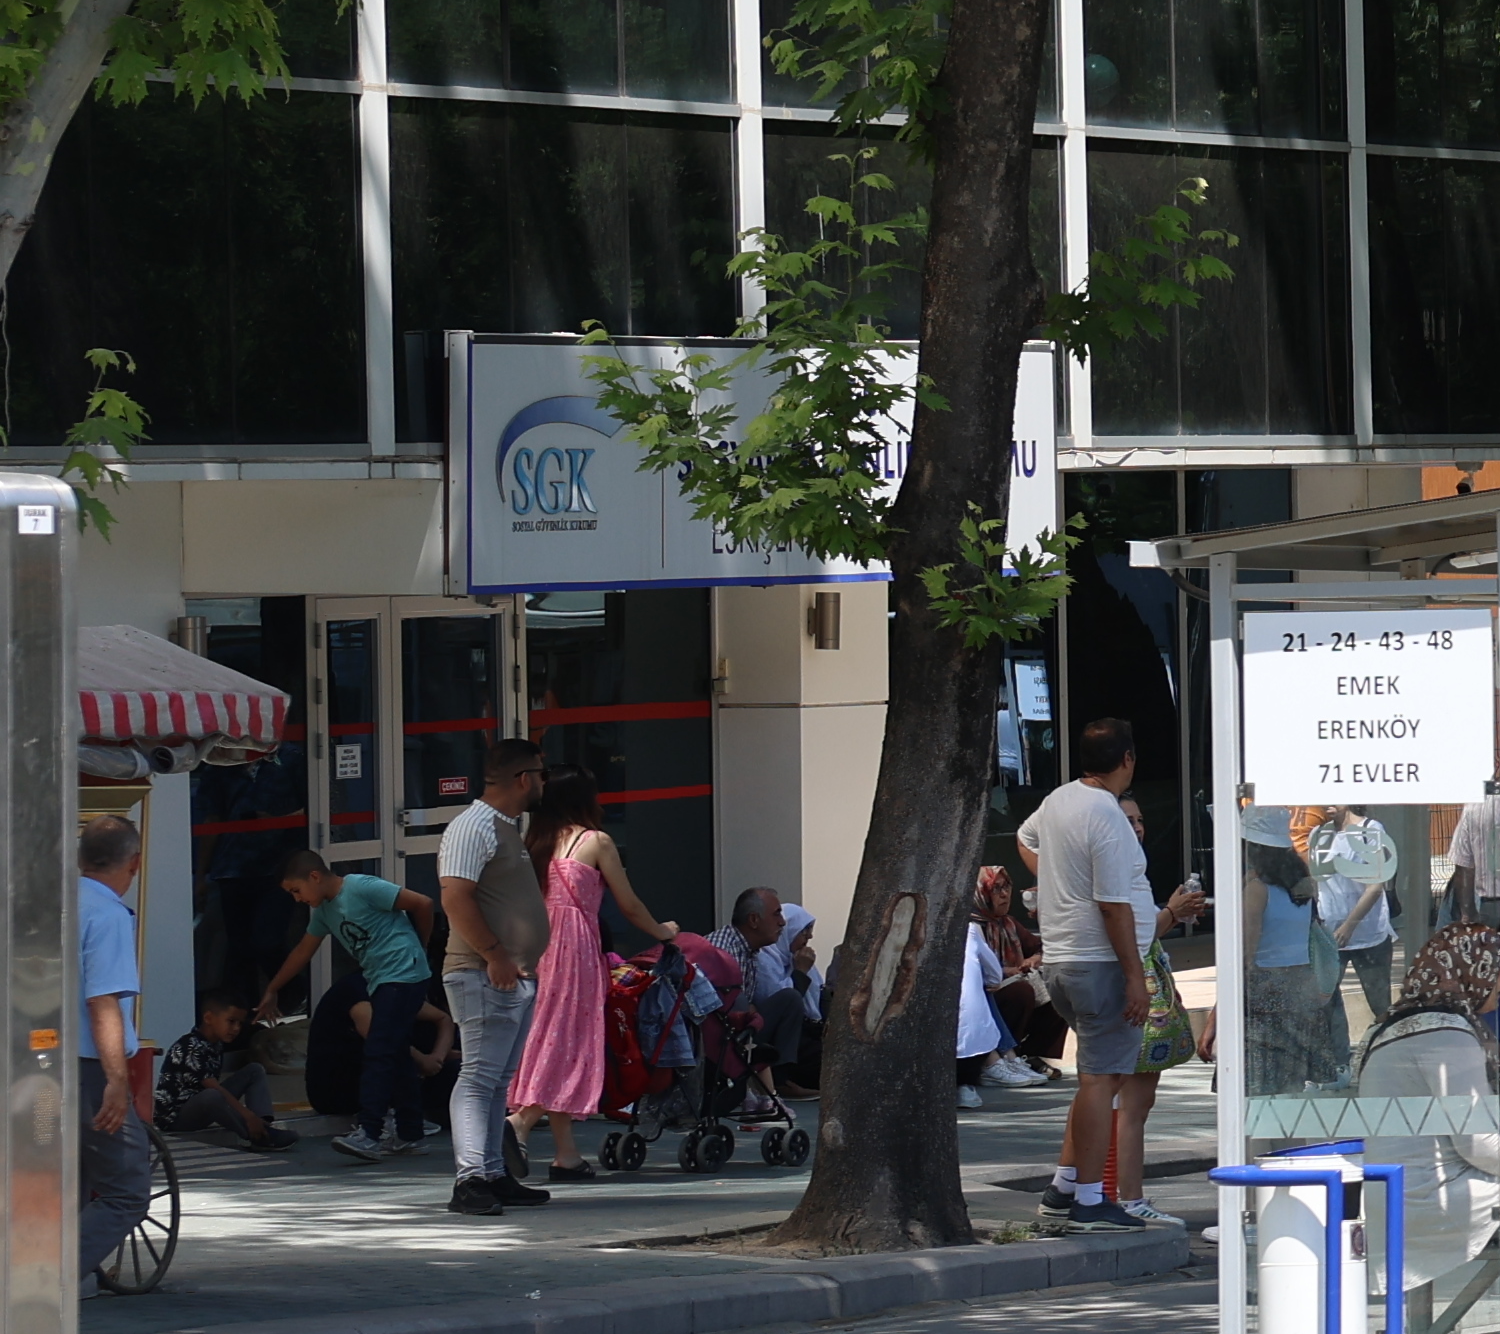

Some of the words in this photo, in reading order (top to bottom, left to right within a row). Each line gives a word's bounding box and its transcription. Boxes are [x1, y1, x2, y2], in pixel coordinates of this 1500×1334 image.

[511, 447, 598, 515] SGK
[1282, 632, 1308, 652] 21
[1330, 631, 1357, 652] 24
[1378, 631, 1405, 651] 43
[1426, 630, 1454, 651] 48
[1337, 675, 1400, 696] EMEK
[1318, 714, 1421, 739] ERENKÖY
[1319, 765, 1344, 783] 71
[1353, 764, 1420, 783] EVLER
